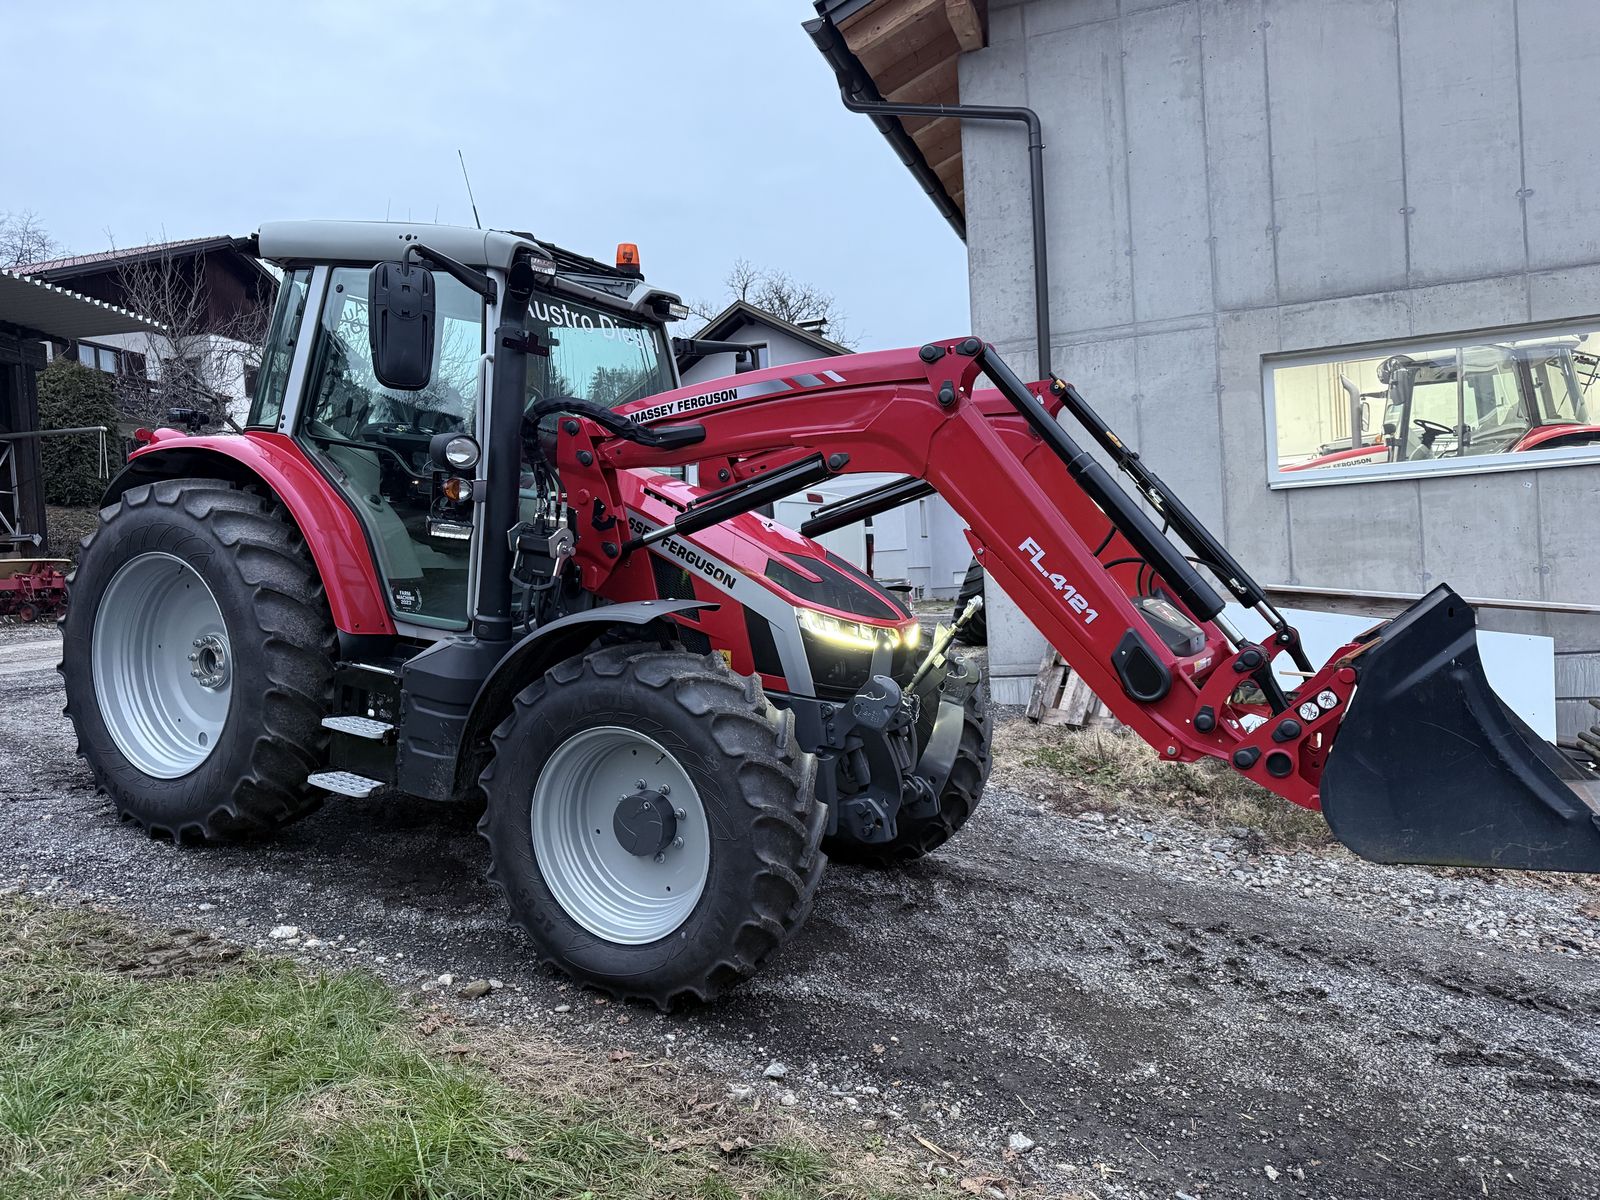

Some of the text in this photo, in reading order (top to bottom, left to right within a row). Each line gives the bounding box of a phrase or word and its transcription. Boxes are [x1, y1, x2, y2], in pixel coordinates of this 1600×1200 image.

[630, 388, 738, 424] MASSEY FERGUSON
[660, 537, 736, 589] FERGUSON
[1018, 536, 1099, 624] FL.4121
